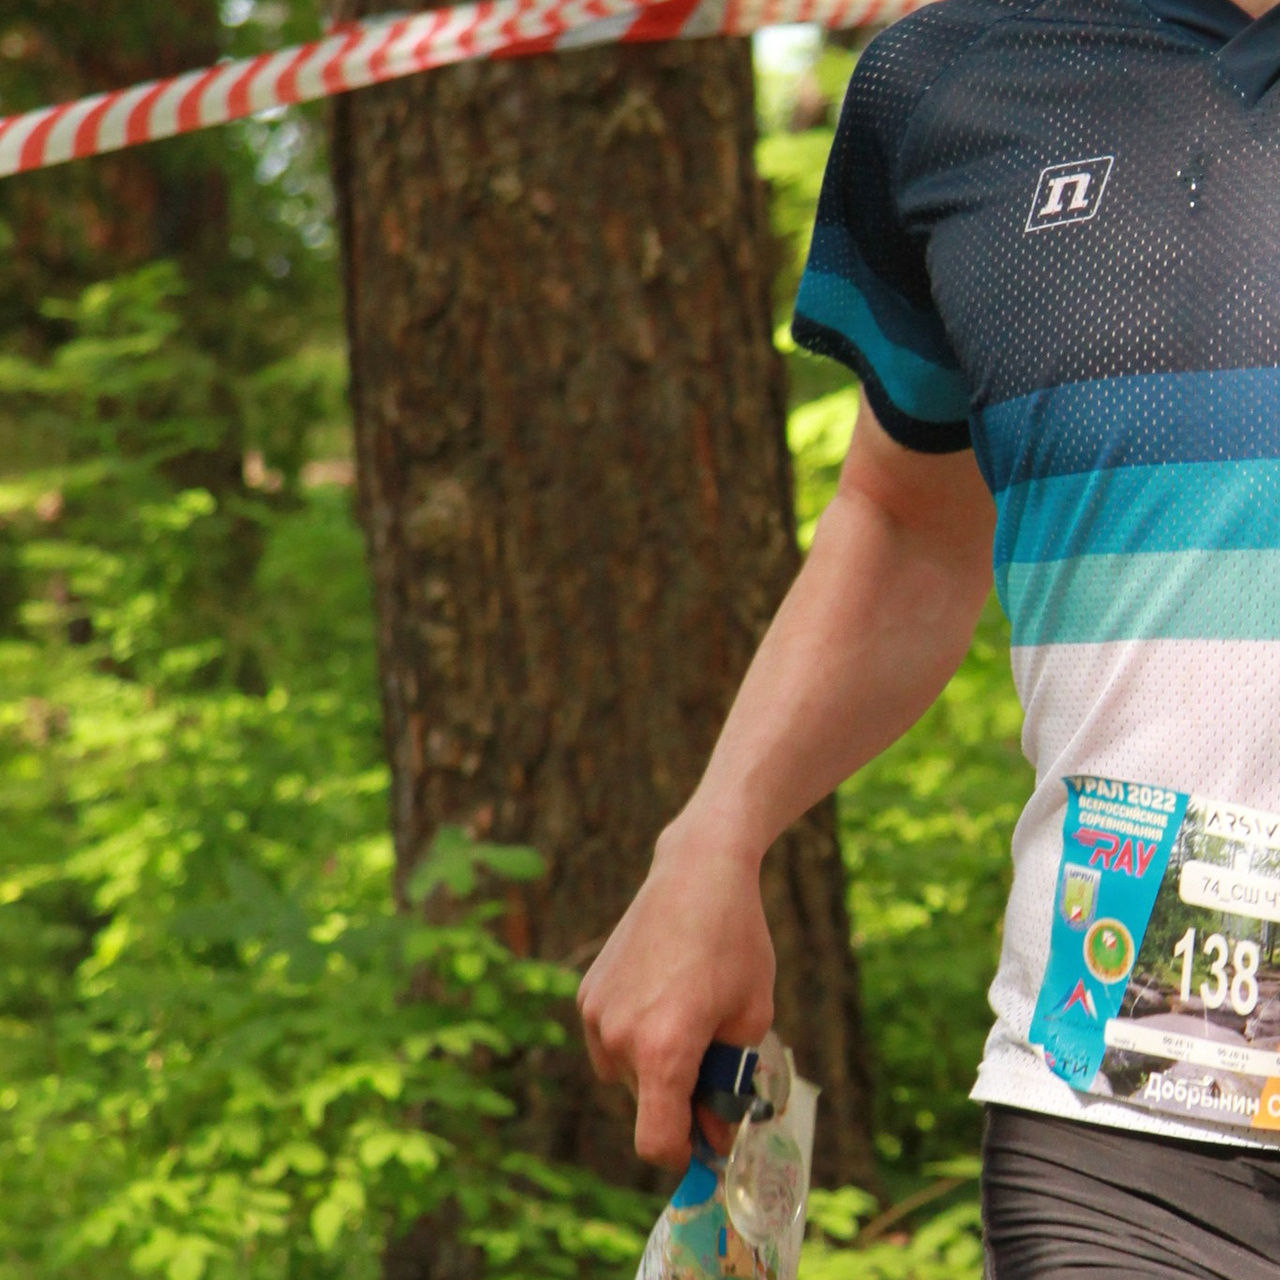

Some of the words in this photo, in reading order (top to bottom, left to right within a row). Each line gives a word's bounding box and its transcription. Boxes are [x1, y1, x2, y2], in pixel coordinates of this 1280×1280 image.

[1078, 795, 1168, 828] ВСЕРОССИЙСКИЕ
[1127, 786, 1177, 813] 2022
[1078, 811, 1163, 841] СОРЕВНОВАНИЯ
[1072, 827, 1157, 878] RAY
[1201, 875, 1260, 904] 74_СШ
[1173, 926, 1261, 1017] 138
[1144, 1070, 1260, 1116] Добрынин
